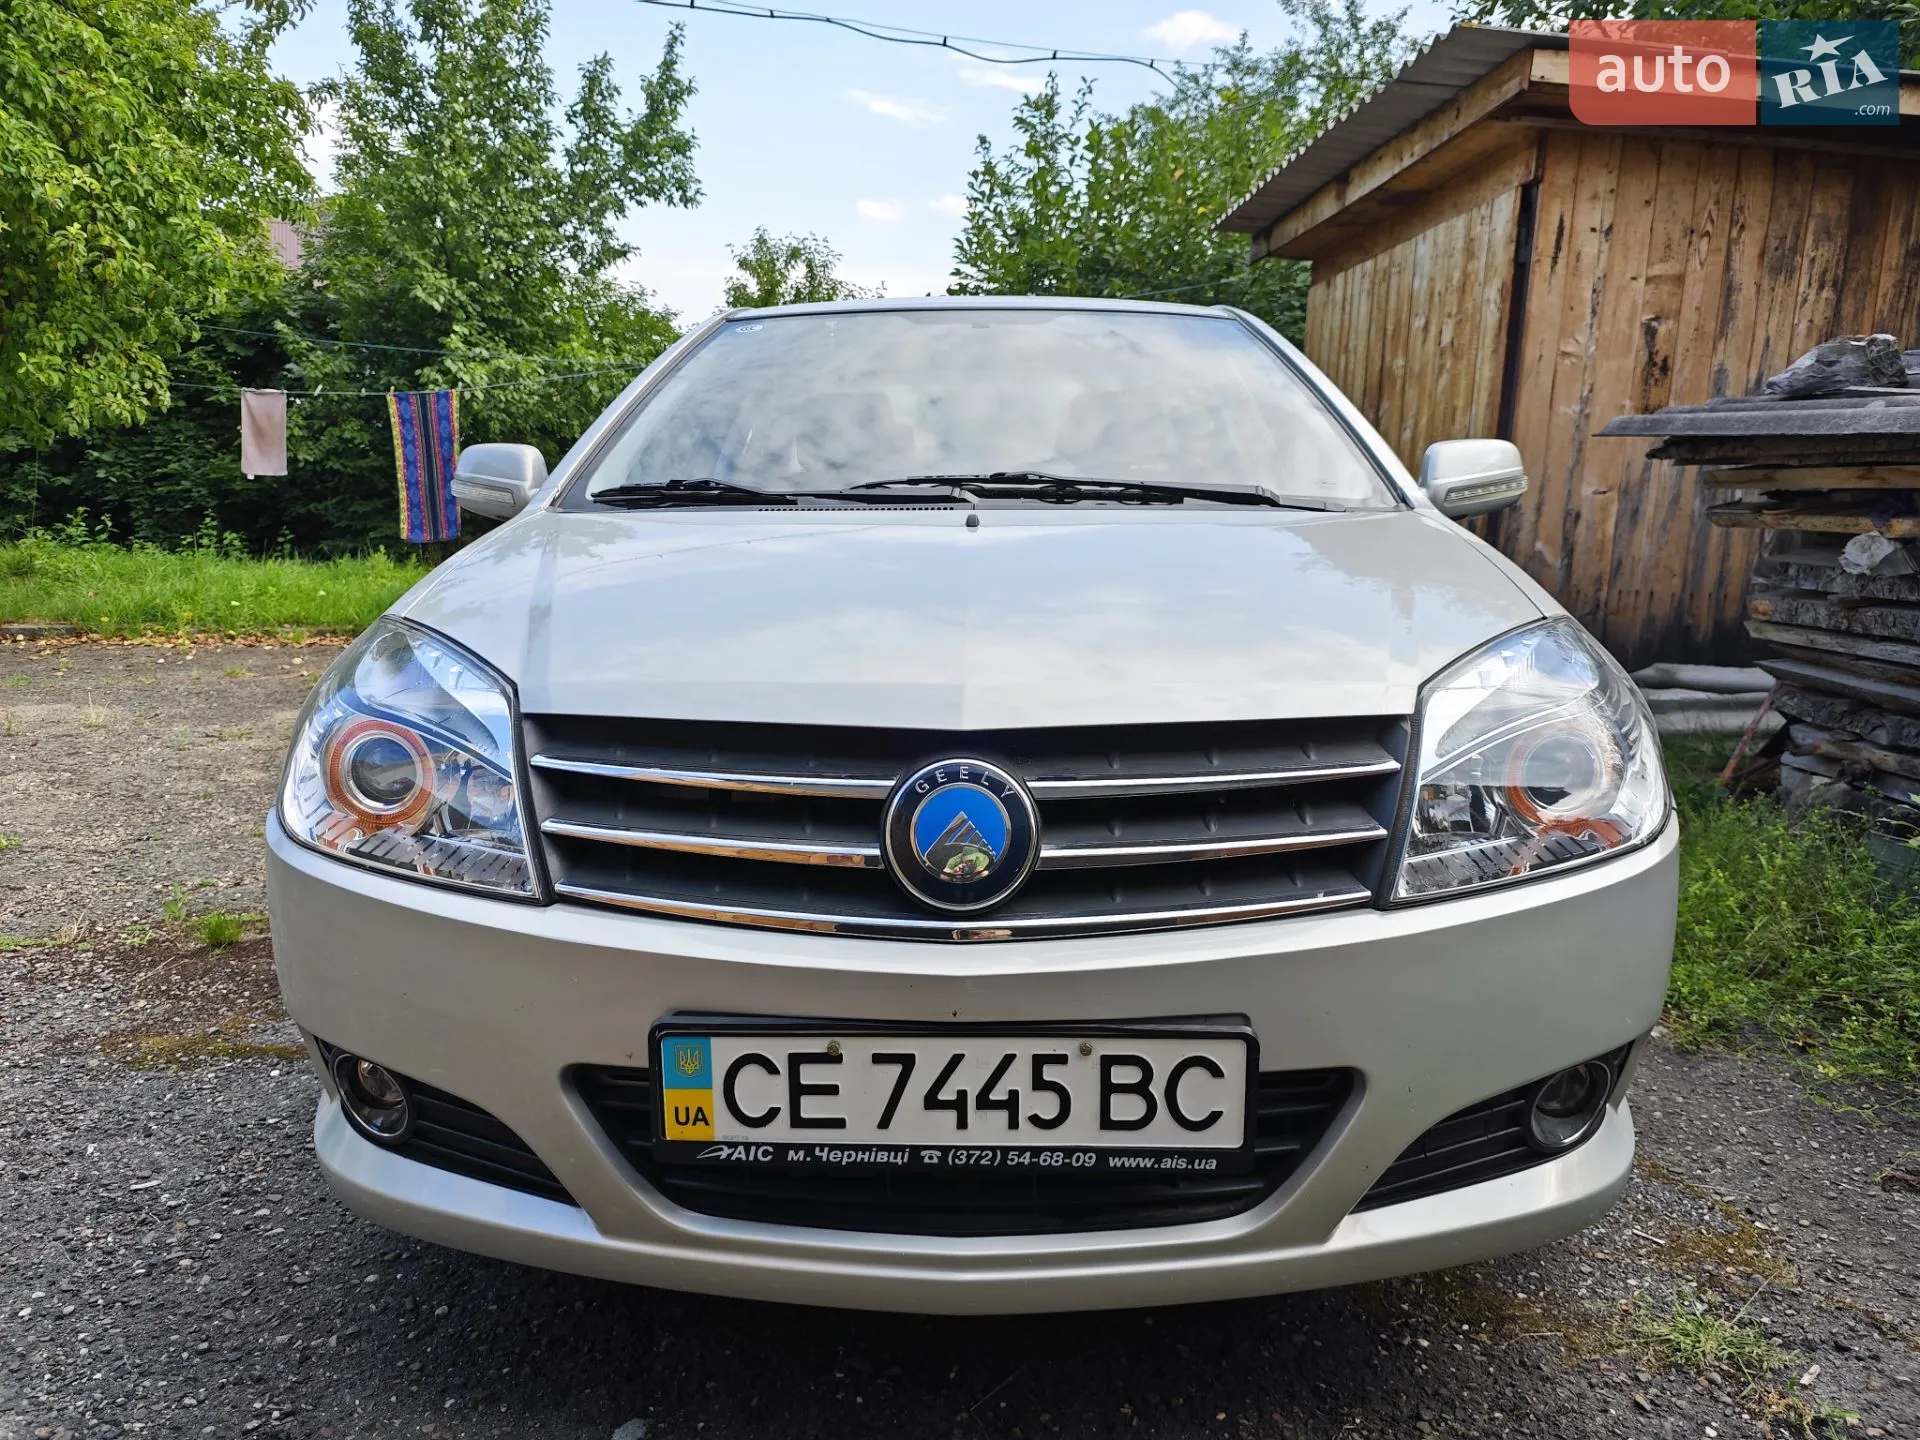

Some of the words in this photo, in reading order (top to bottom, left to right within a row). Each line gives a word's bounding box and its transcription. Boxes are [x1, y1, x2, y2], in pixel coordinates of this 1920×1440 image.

[914, 766, 1016, 798] GEELY
[722, 1051, 848, 1129] CE
[871, 1052, 1073, 1130] 7445
[1099, 1053, 1226, 1132] BC
[674, 1104, 710, 1127] UA
[948, 1149, 1001, 1166] (372)
[1006, 1151, 1097, 1167] 54-68-09
[1108, 1155, 1218, 1170] www.ais.ua
